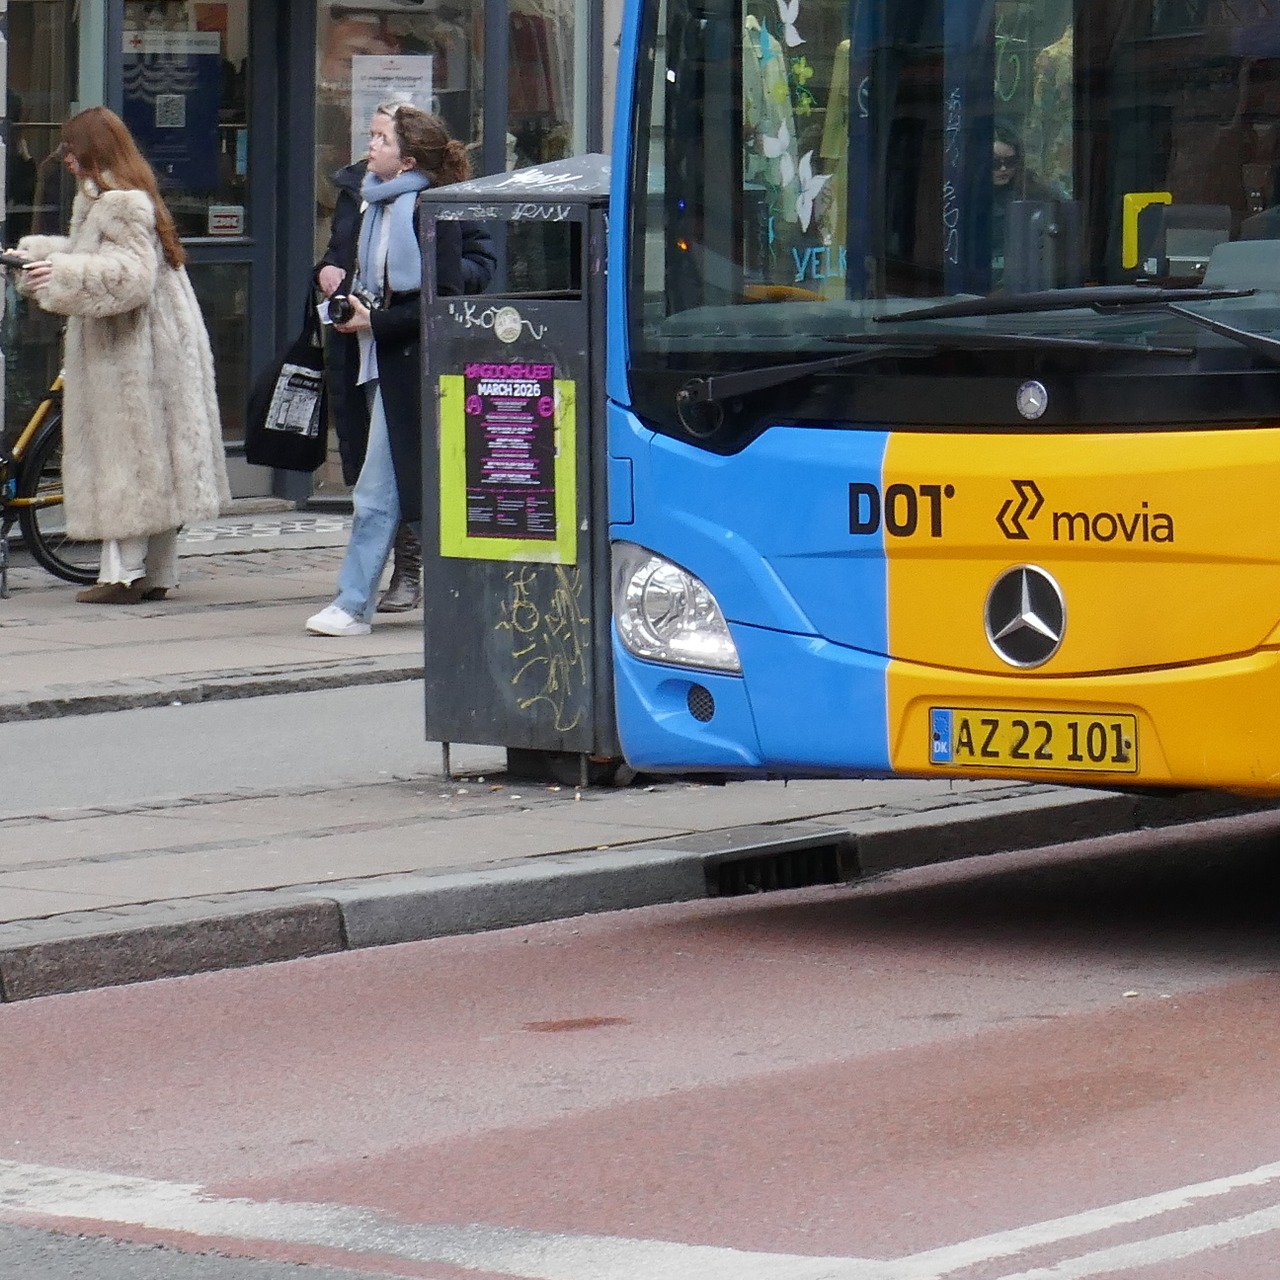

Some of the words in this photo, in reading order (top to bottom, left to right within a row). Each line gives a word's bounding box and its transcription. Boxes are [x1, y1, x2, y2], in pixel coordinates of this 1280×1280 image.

[477, 383, 512, 397] MARCH
[513, 384, 541, 397] 2026
[848, 482, 955, 539] DOT
[1052, 501, 1175, 543] movia
[933, 740, 948, 754] DK
[955, 717, 999, 758] AZ
[1010, 721, 1053, 761] 22
[1067, 721, 1130, 764] 101
